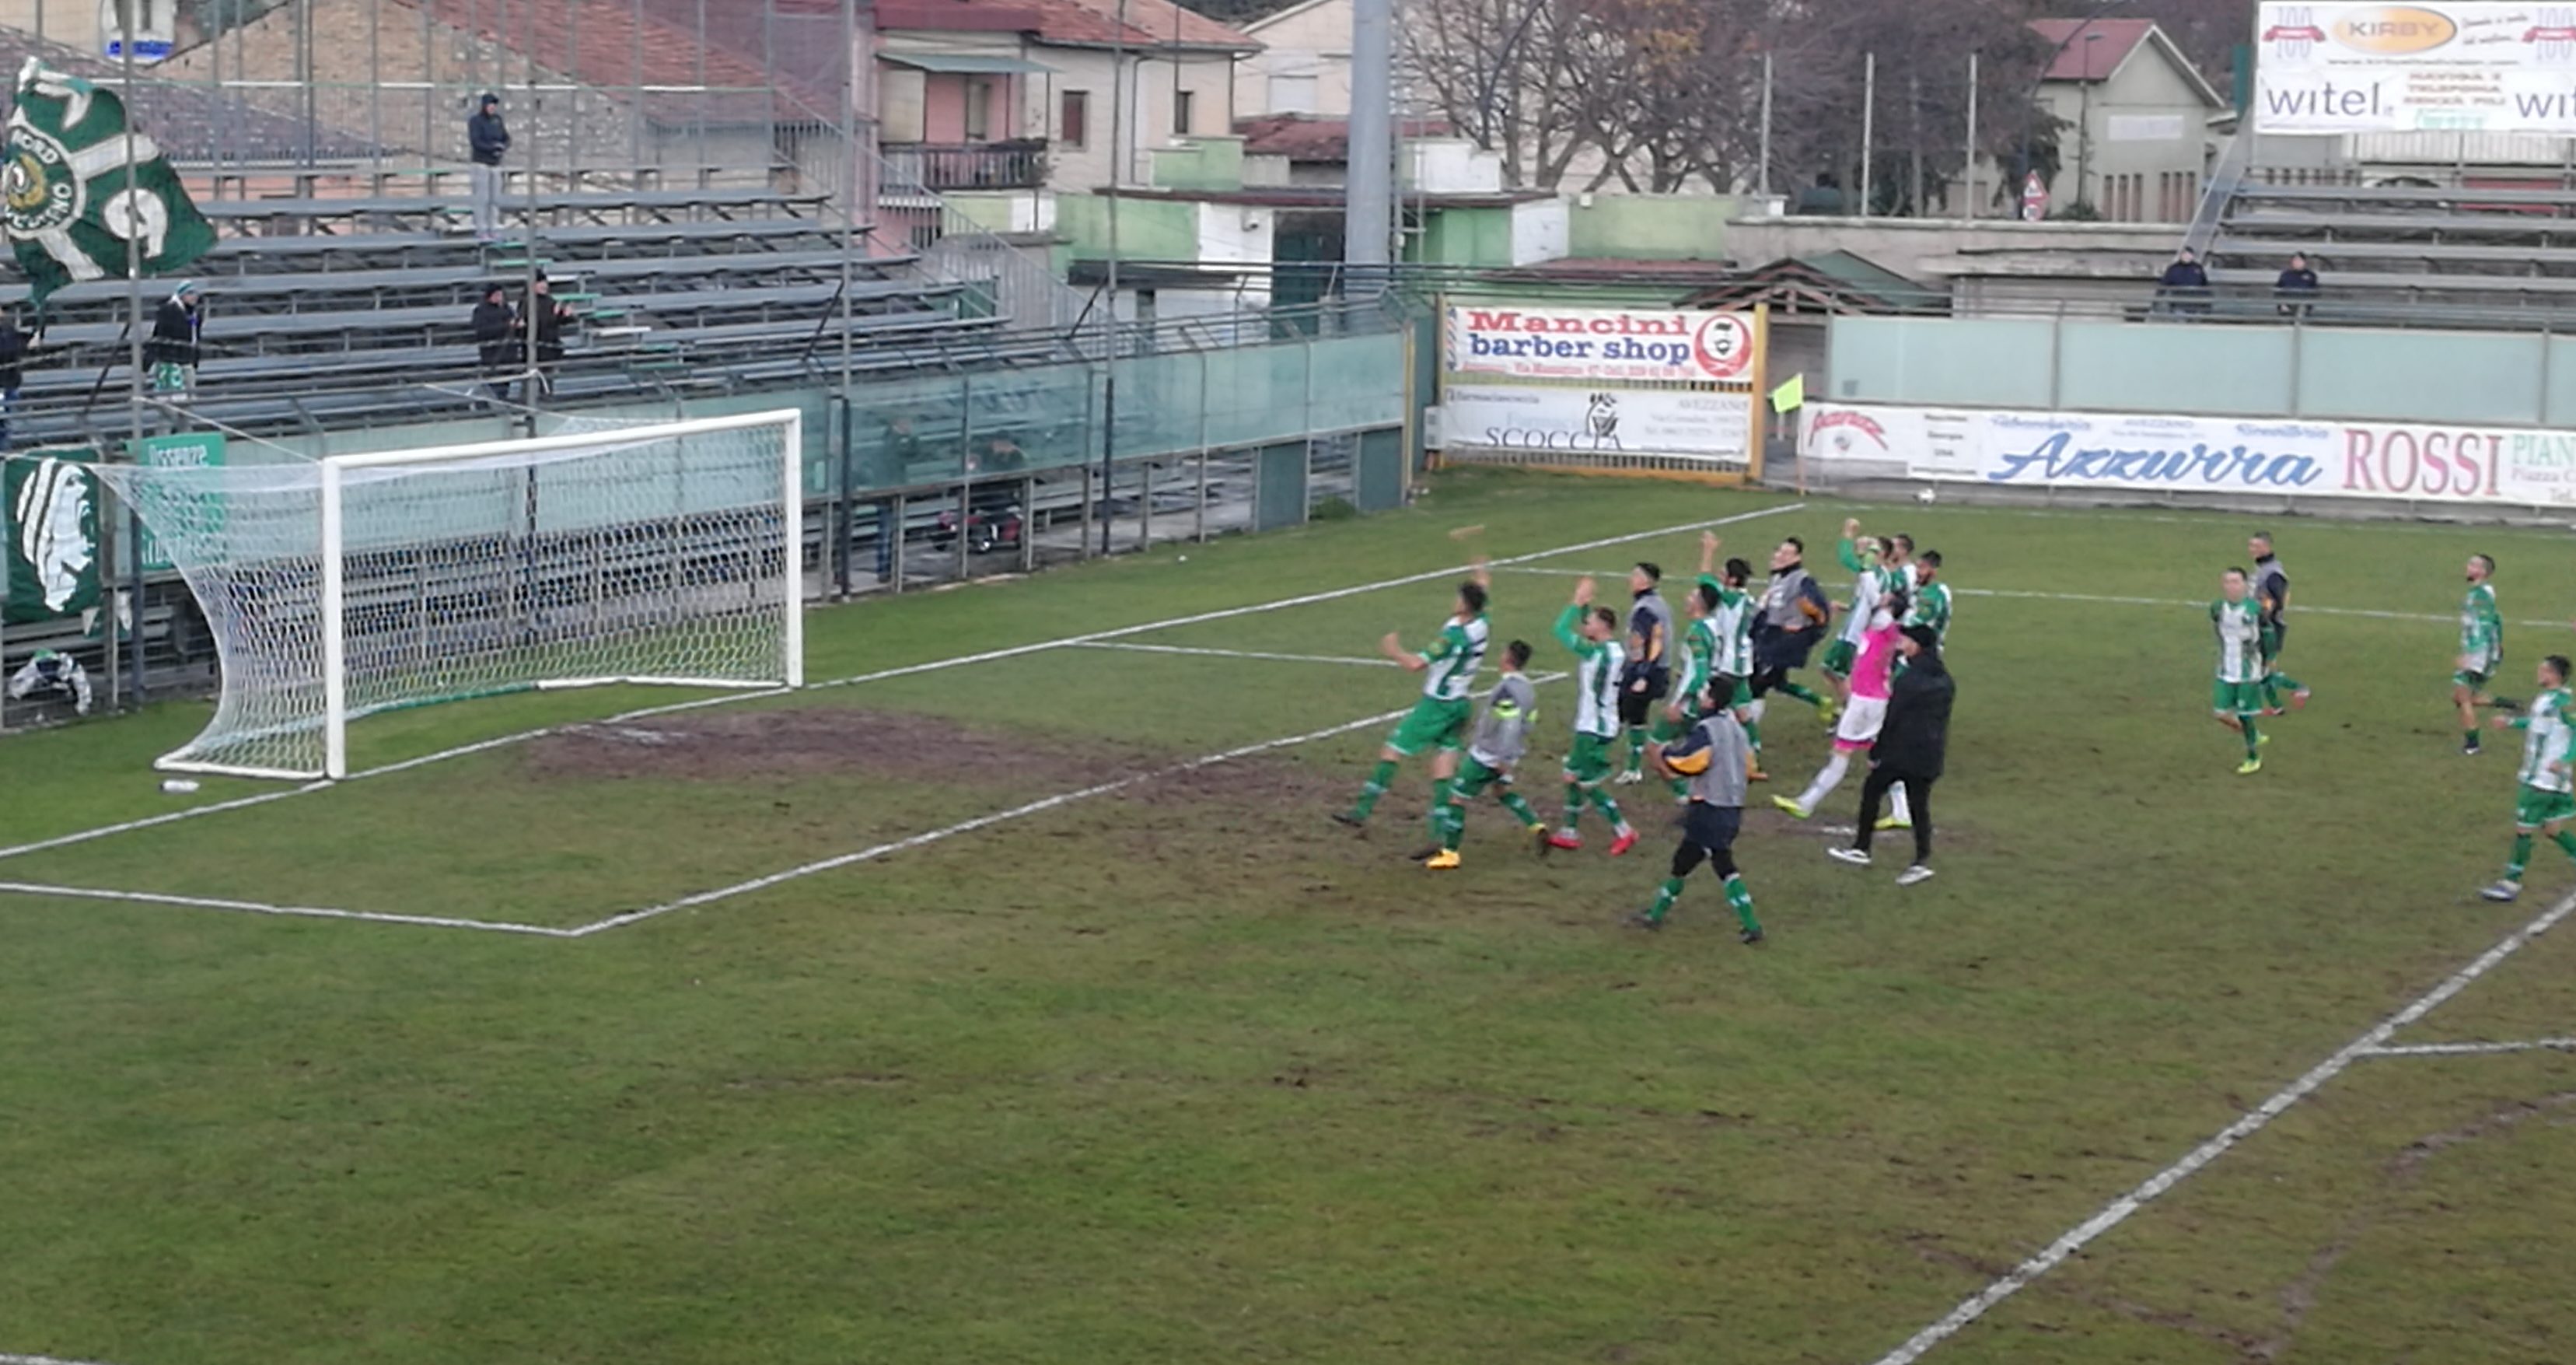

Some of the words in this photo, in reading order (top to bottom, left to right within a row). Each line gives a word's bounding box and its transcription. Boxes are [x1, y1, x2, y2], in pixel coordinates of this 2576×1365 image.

[2348, 22, 2440, 37] KIRBY
[1467, 311, 1691, 336] Mancini
[1470, 334, 1594, 359] barber
[1602, 338, 1691, 365] shop
[1485, 426, 1624, 451] SCOCCIA
[1987, 431, 2323, 487] Azzurra
[2340, 427, 2505, 496] ROSSI
